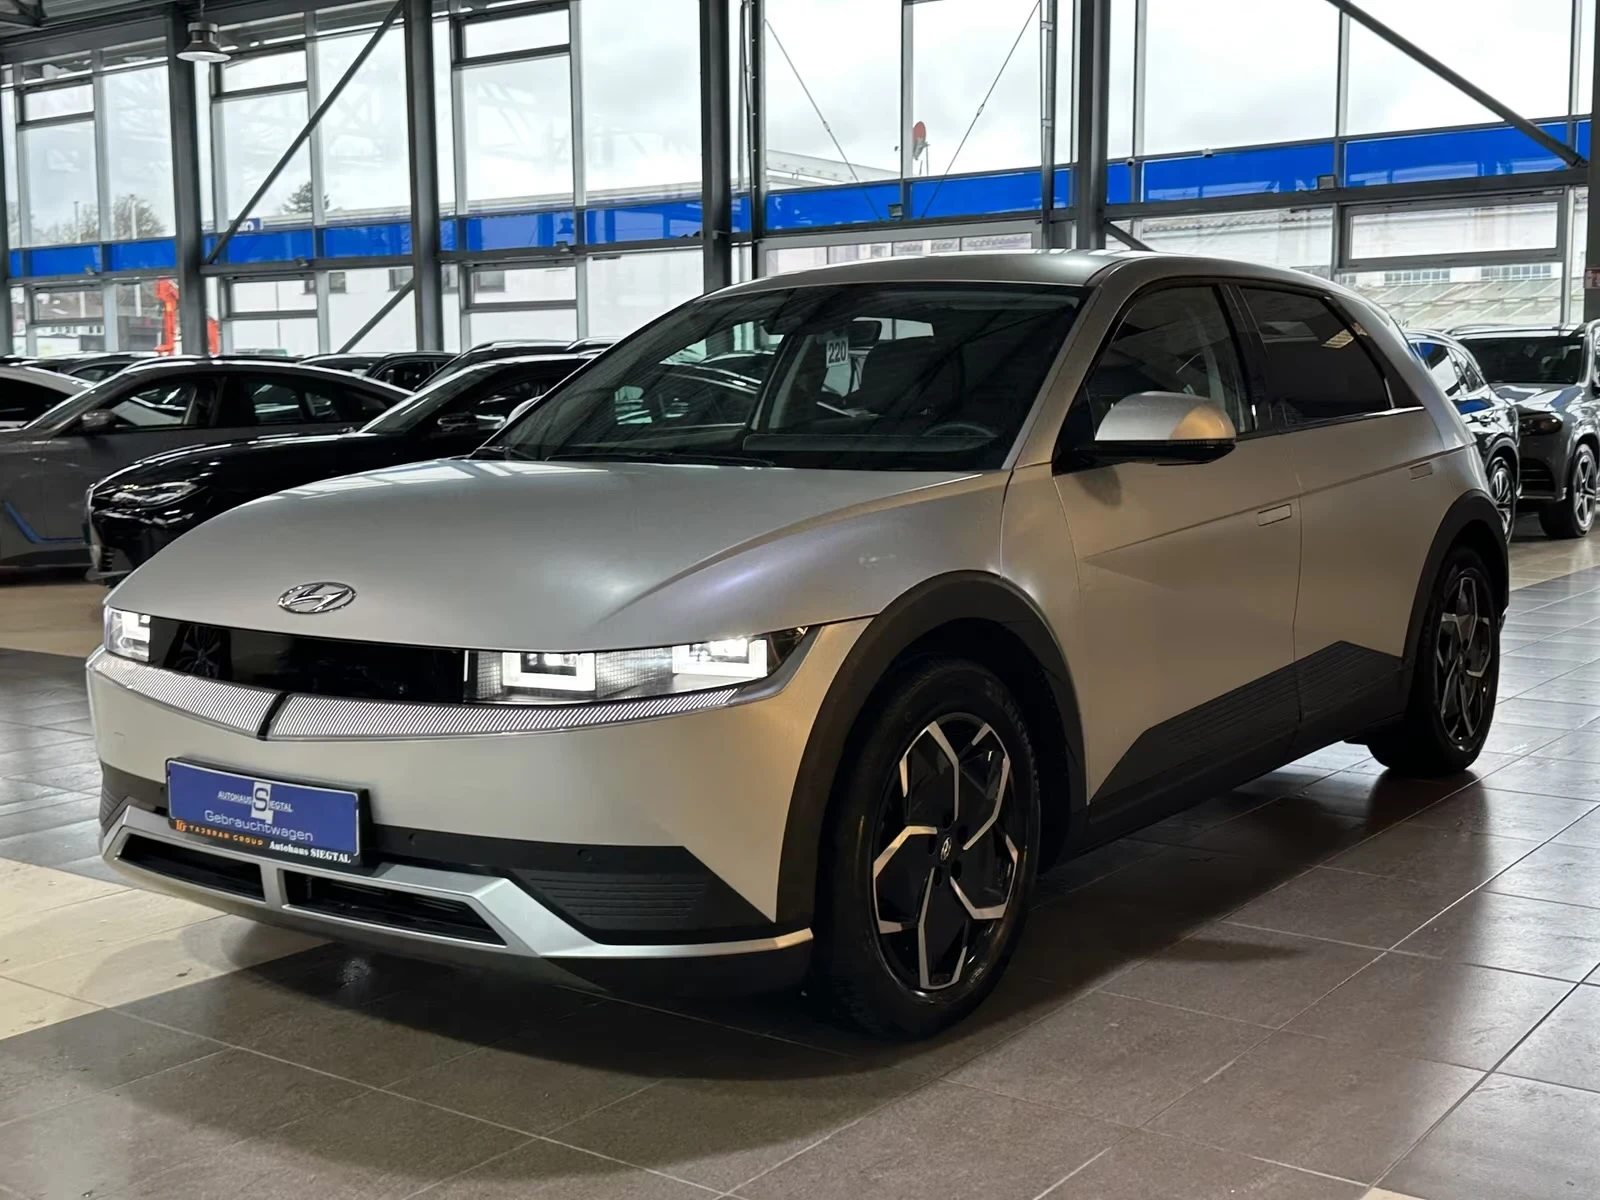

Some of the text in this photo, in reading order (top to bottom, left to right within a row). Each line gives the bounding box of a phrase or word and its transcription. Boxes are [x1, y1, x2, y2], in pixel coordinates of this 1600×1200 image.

[828, 341, 847, 363] 220
[217, 790, 253, 806] AUTOHAUS
[204, 809, 314, 841] Gebrauchtwagen
[232, 834, 264, 846] GROUP
[269, 840, 352, 864] Autohaus SIEGTAL
